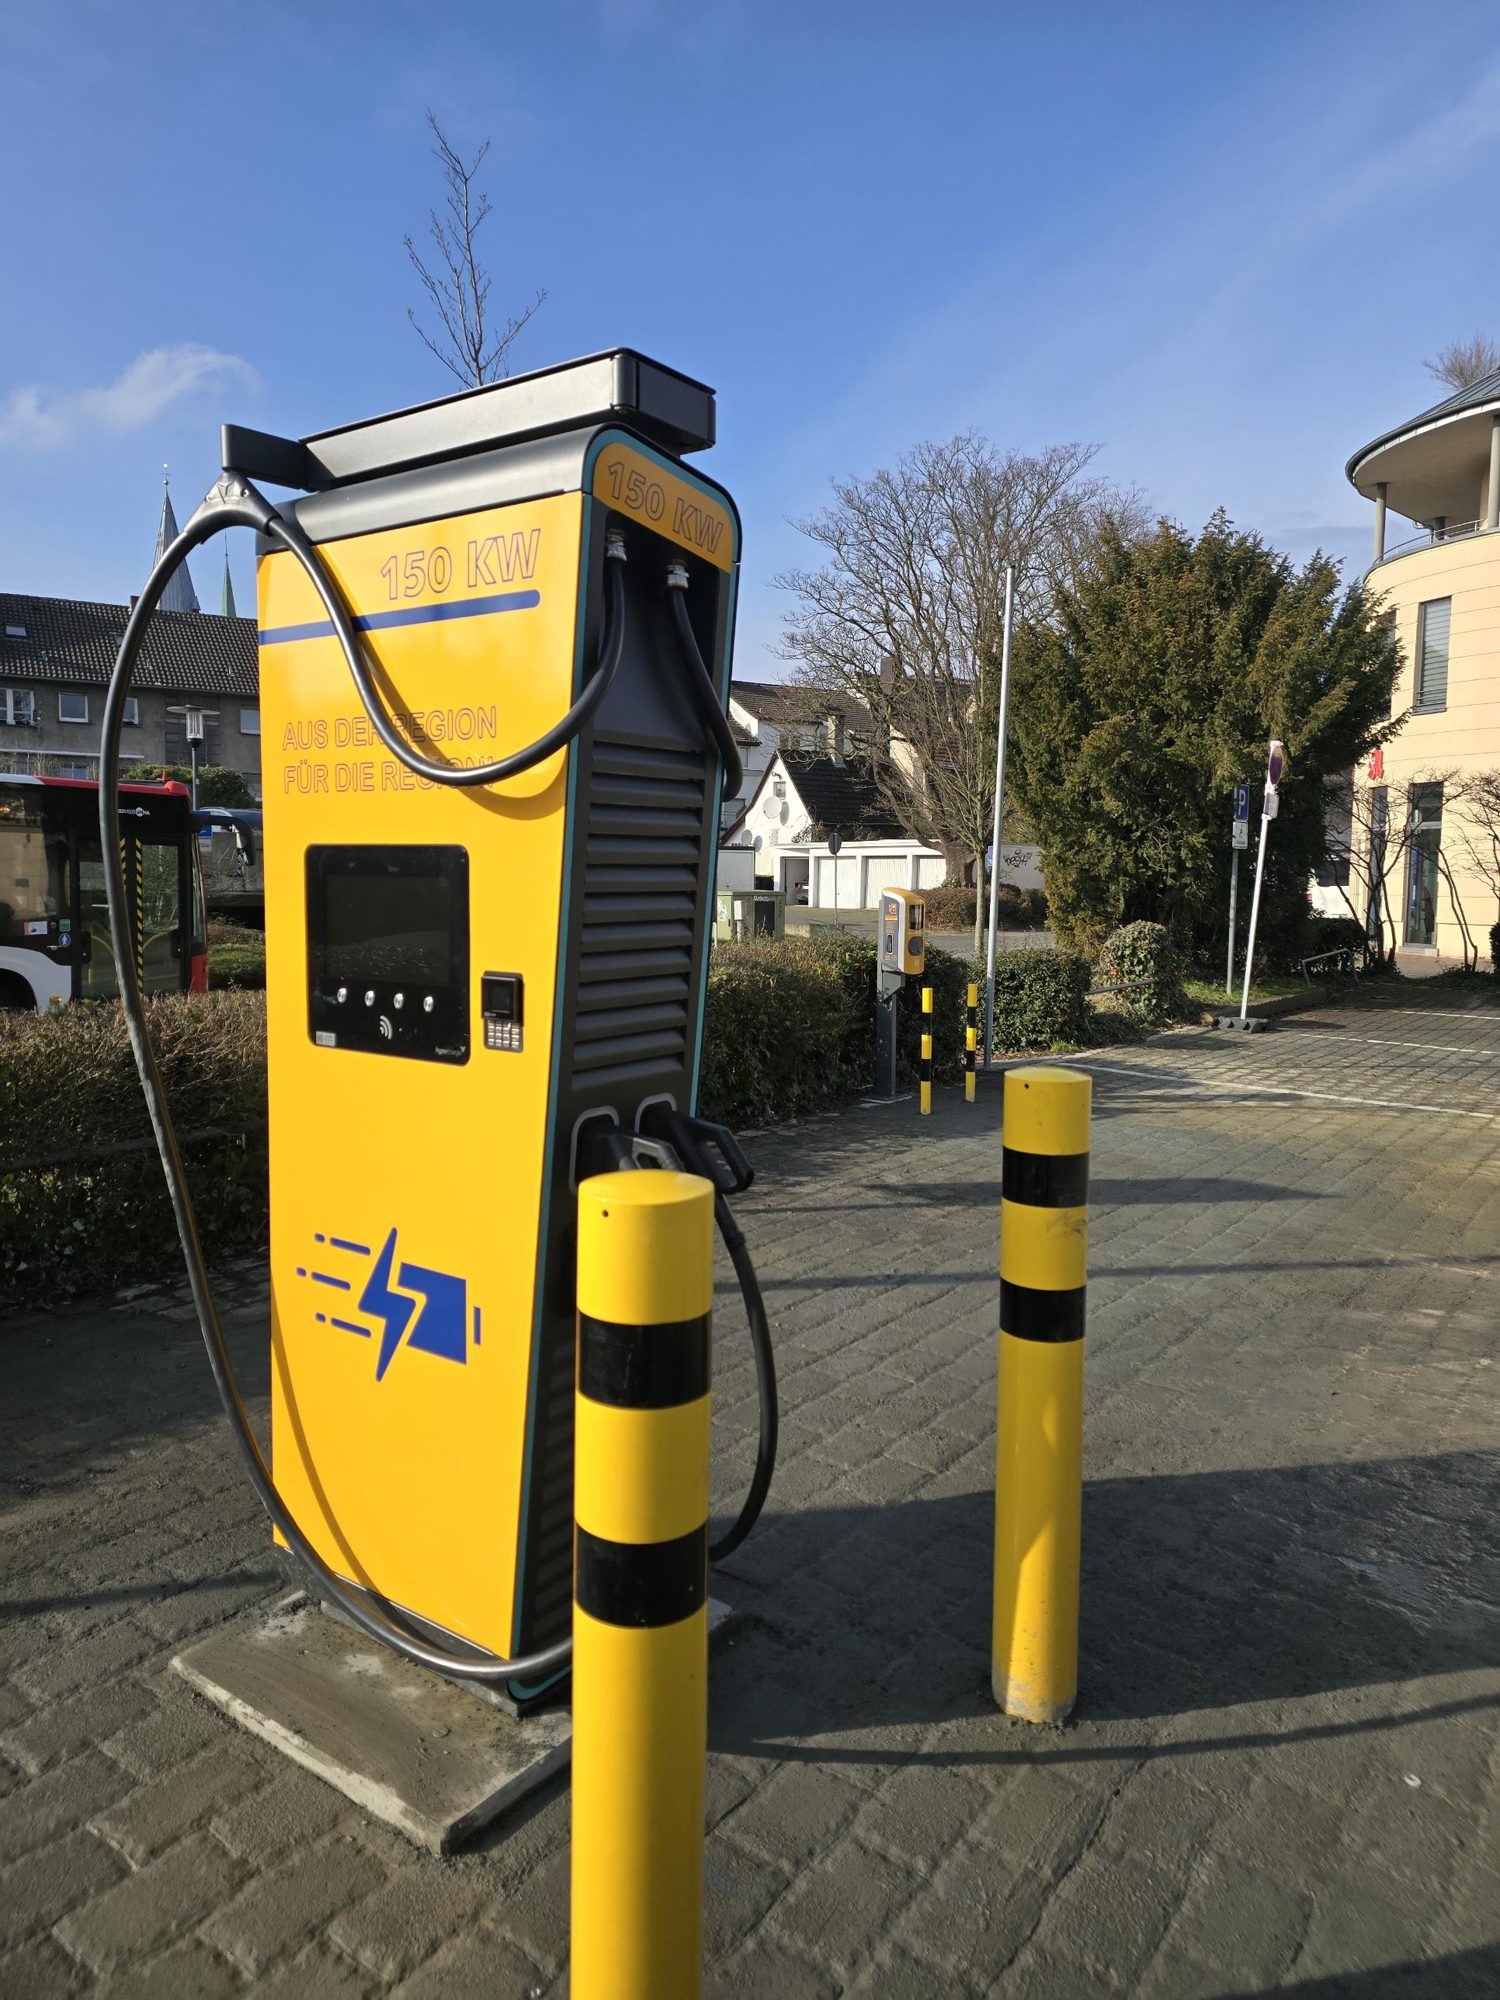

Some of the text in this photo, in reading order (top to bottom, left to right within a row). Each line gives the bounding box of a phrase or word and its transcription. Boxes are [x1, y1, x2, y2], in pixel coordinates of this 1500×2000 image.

[608, 461, 724, 554] 150 KW
[380, 528, 541, 600] 150 KW
[283, 706, 497, 750] AUS DER REGION
[284, 759, 329, 794] FÜR
[335, 762, 374, 792] DIE
